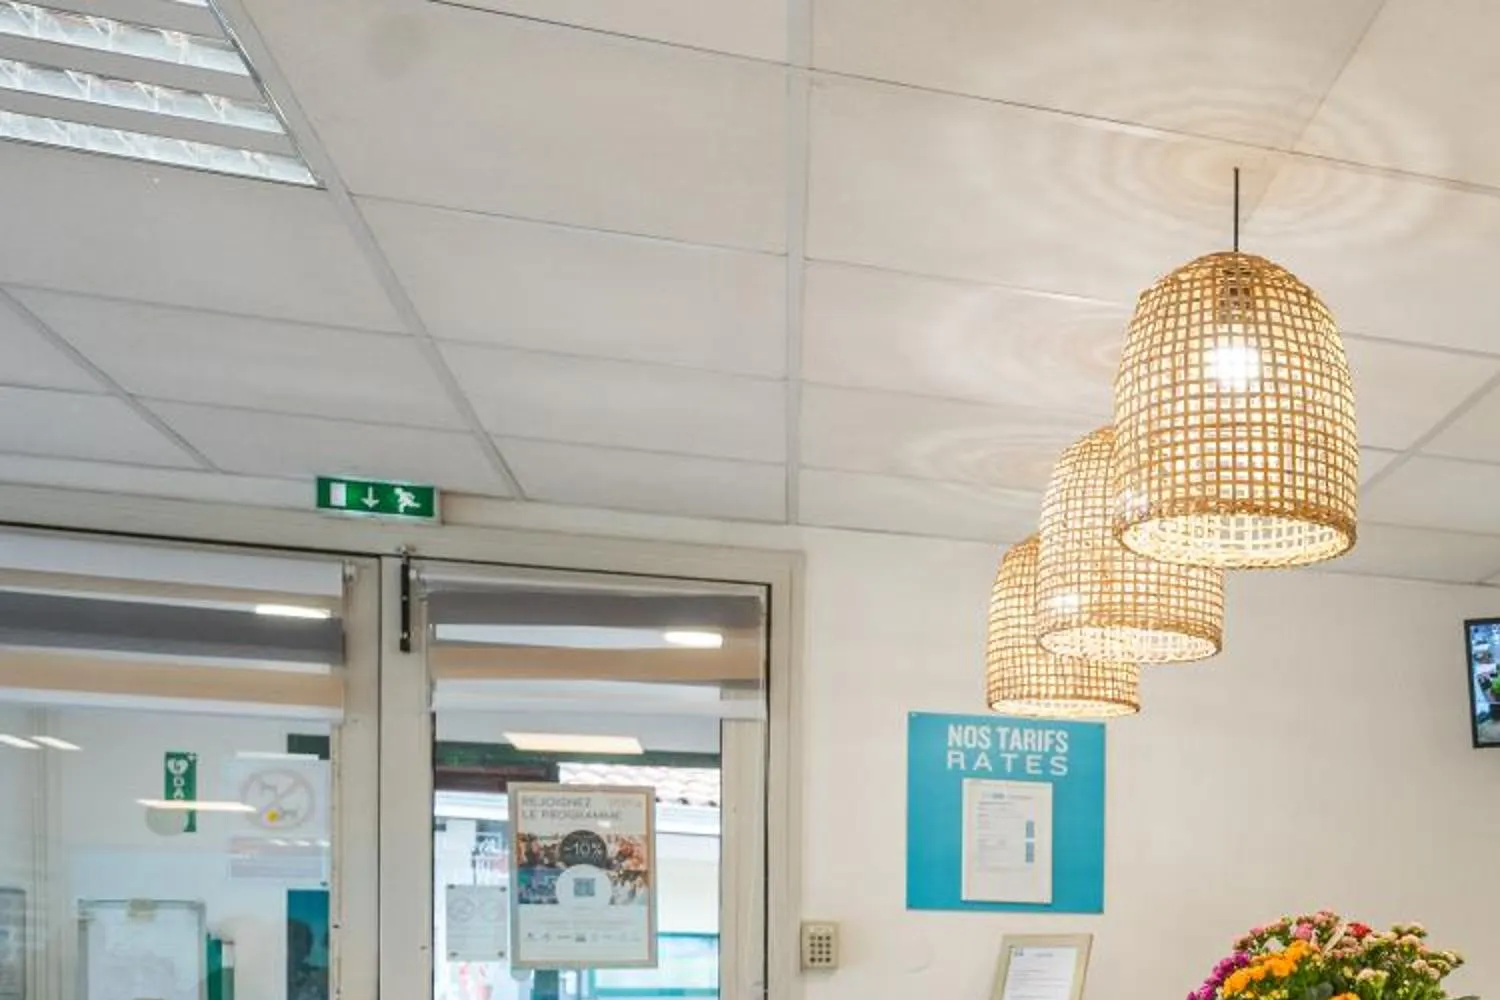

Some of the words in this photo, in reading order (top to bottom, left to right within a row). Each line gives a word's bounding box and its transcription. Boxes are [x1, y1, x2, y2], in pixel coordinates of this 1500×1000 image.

[947, 724, 992, 750] NOS
[996, 727, 1069, 753] TARIFS
[947, 750, 1068, 776] RATES
[522, 809, 537, 820] LE
